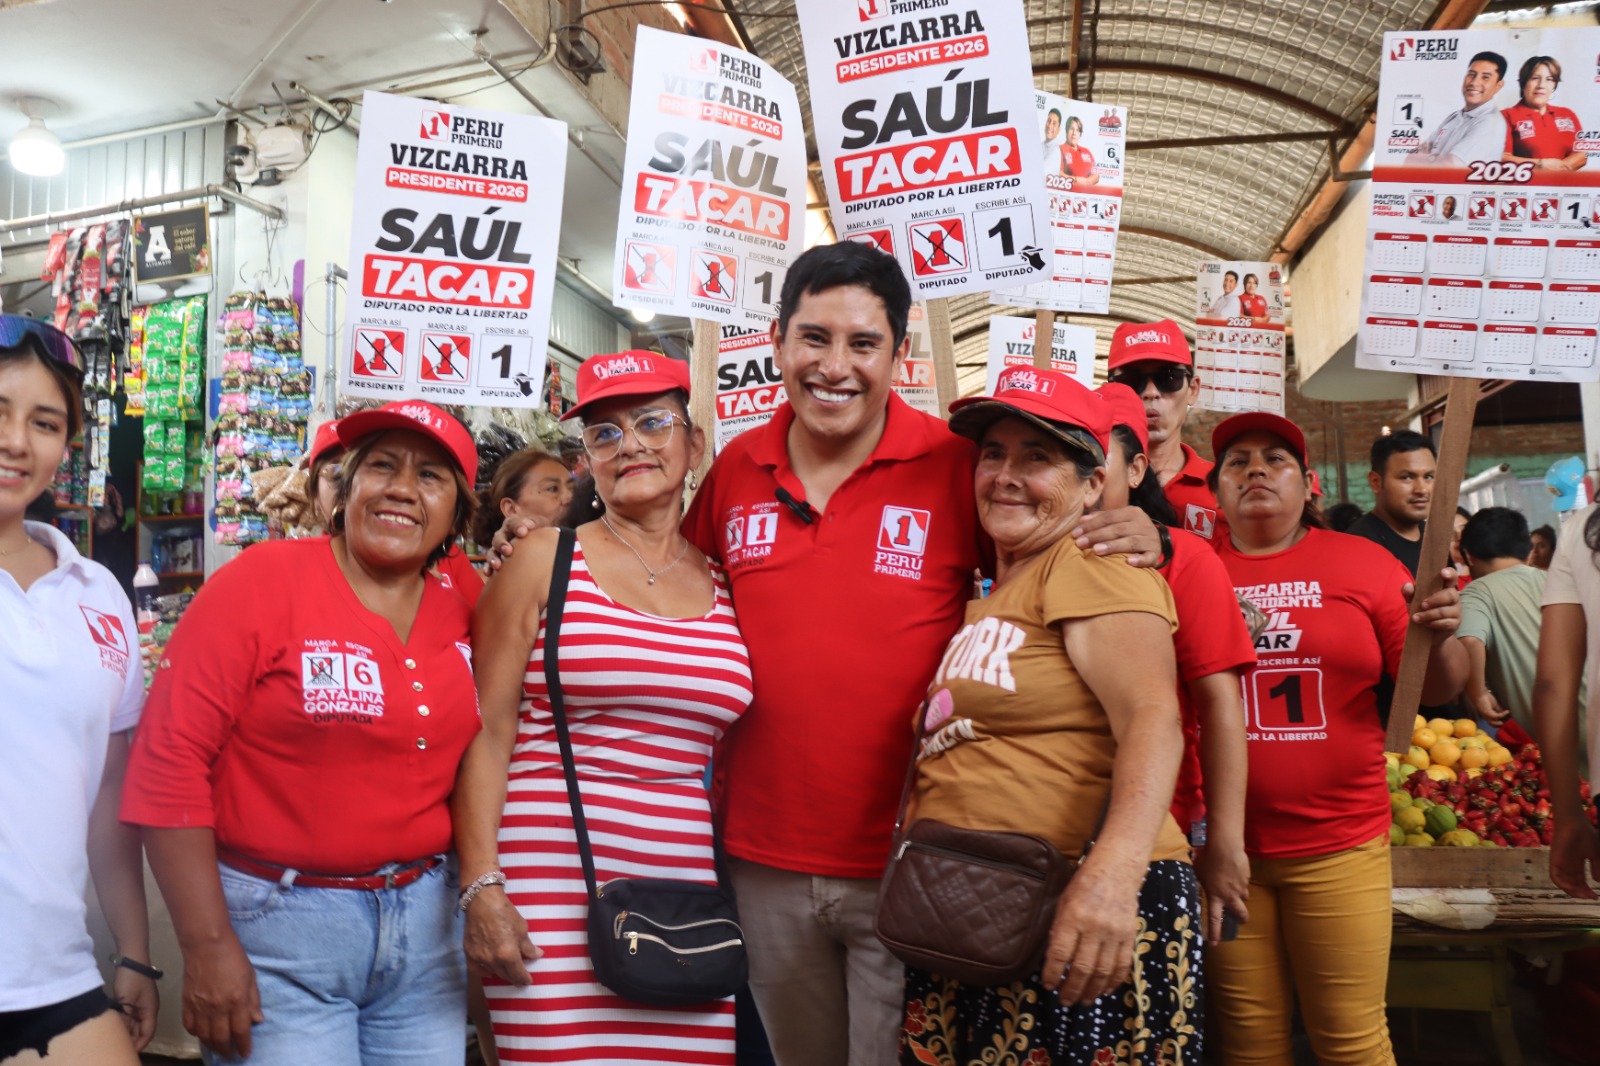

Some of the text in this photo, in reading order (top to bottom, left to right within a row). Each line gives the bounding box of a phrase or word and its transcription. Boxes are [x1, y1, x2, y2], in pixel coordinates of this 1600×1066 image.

[890, 0, 949, 15] PRIMERO
[834, 9, 985, 59] VIZCARRA
[838, 39, 985, 79] PRESIDENTE 2026
[1415, 52, 1458, 61] PRIMERO
[720, 68, 762, 89] PRIMERO
[841, 67, 1009, 150] SAÚL
[1401, 102, 1413, 120] 1
[429, 116, 440, 136] 1
[750, 117, 781, 136] 2026
[451, 133, 503, 150] PRIMERO
[1107, 147, 1116, 158] 6
[390, 143, 528, 181] VIZCARRA
[648, 131, 788, 198] SAÚL
[842, 135, 1012, 197] TACAR
[1467, 162, 1532, 182] 2026
[388, 171, 526, 199] PRESIDENTE 2026
[1046, 174, 1073, 190] 2026
[845, 178, 1021, 214] DIPUTADO POR LA LIBERTAD
[975, 199, 1009, 210] ESCRIBE
[644, 177, 787, 236] TACAR
[911, 210, 940, 220] MARCA
[1091, 203, 1098, 214] 1
[1567, 202, 1580, 220] 1
[847, 221, 871, 231] MARCA
[375, 206, 533, 265] SAÚL
[722, 229, 736, 239] LA
[738, 233, 786, 251] LIBERTAD
[988, 216, 1015, 257] 1
[928, 229, 951, 267] 1
[371, 259, 529, 305] TACAR
[705, 261, 721, 294] 1
[985, 266, 1033, 280] DIPUTADO
[754, 270, 773, 305] 1
[918, 276, 968, 290] DIPUTADO
[364, 300, 528, 320] DIPUTADO POR LA LIBERTAD
[691, 302, 731, 314] DIPUTADO
[745, 311, 773, 323] DIPUTA
[360, 317, 388, 326] MARCA
[428, 322, 454, 331] MARCA
[1227, 317, 1252, 328] 2026
[485, 327, 515, 335] ESCRIBE
[719, 334, 772, 350] RESIDENTE
[369, 338, 387, 371] 1
[436, 343, 453, 375] 1
[491, 344, 512, 379] 1
[607, 354, 638, 368] SAÚL
[1006, 342, 1077, 363] VIZRRA
[610, 366, 636, 376] TACAR
[1010, 370, 1038, 383] SAÚL
[348, 380, 405, 391] PRESIDENTE
[421, 386, 466, 396] DIPUTADO
[480, 389, 522, 398] DIPUTADO
[1040, 381, 1050, 393] 1
[721, 416, 757, 427] DIPUTADO
[756, 517, 768, 541] 1
[894, 515, 911, 546] 1
[1194, 511, 1206, 532] 1
[741, 546, 772, 559] TACAR
[875, 550, 924, 570] PERÚ
[874, 564, 921, 580] PRIMERO
[97, 616, 119, 646] 1
[354, 661, 374, 686] 6
[303, 688, 385, 706] CATALINA
[1269, 674, 1305, 724] 1
[304, 701, 384, 718] GONZALES
[313, 713, 373, 725] DIPUTADA
[1262, 732, 1328, 741] LA LIBERTAD
